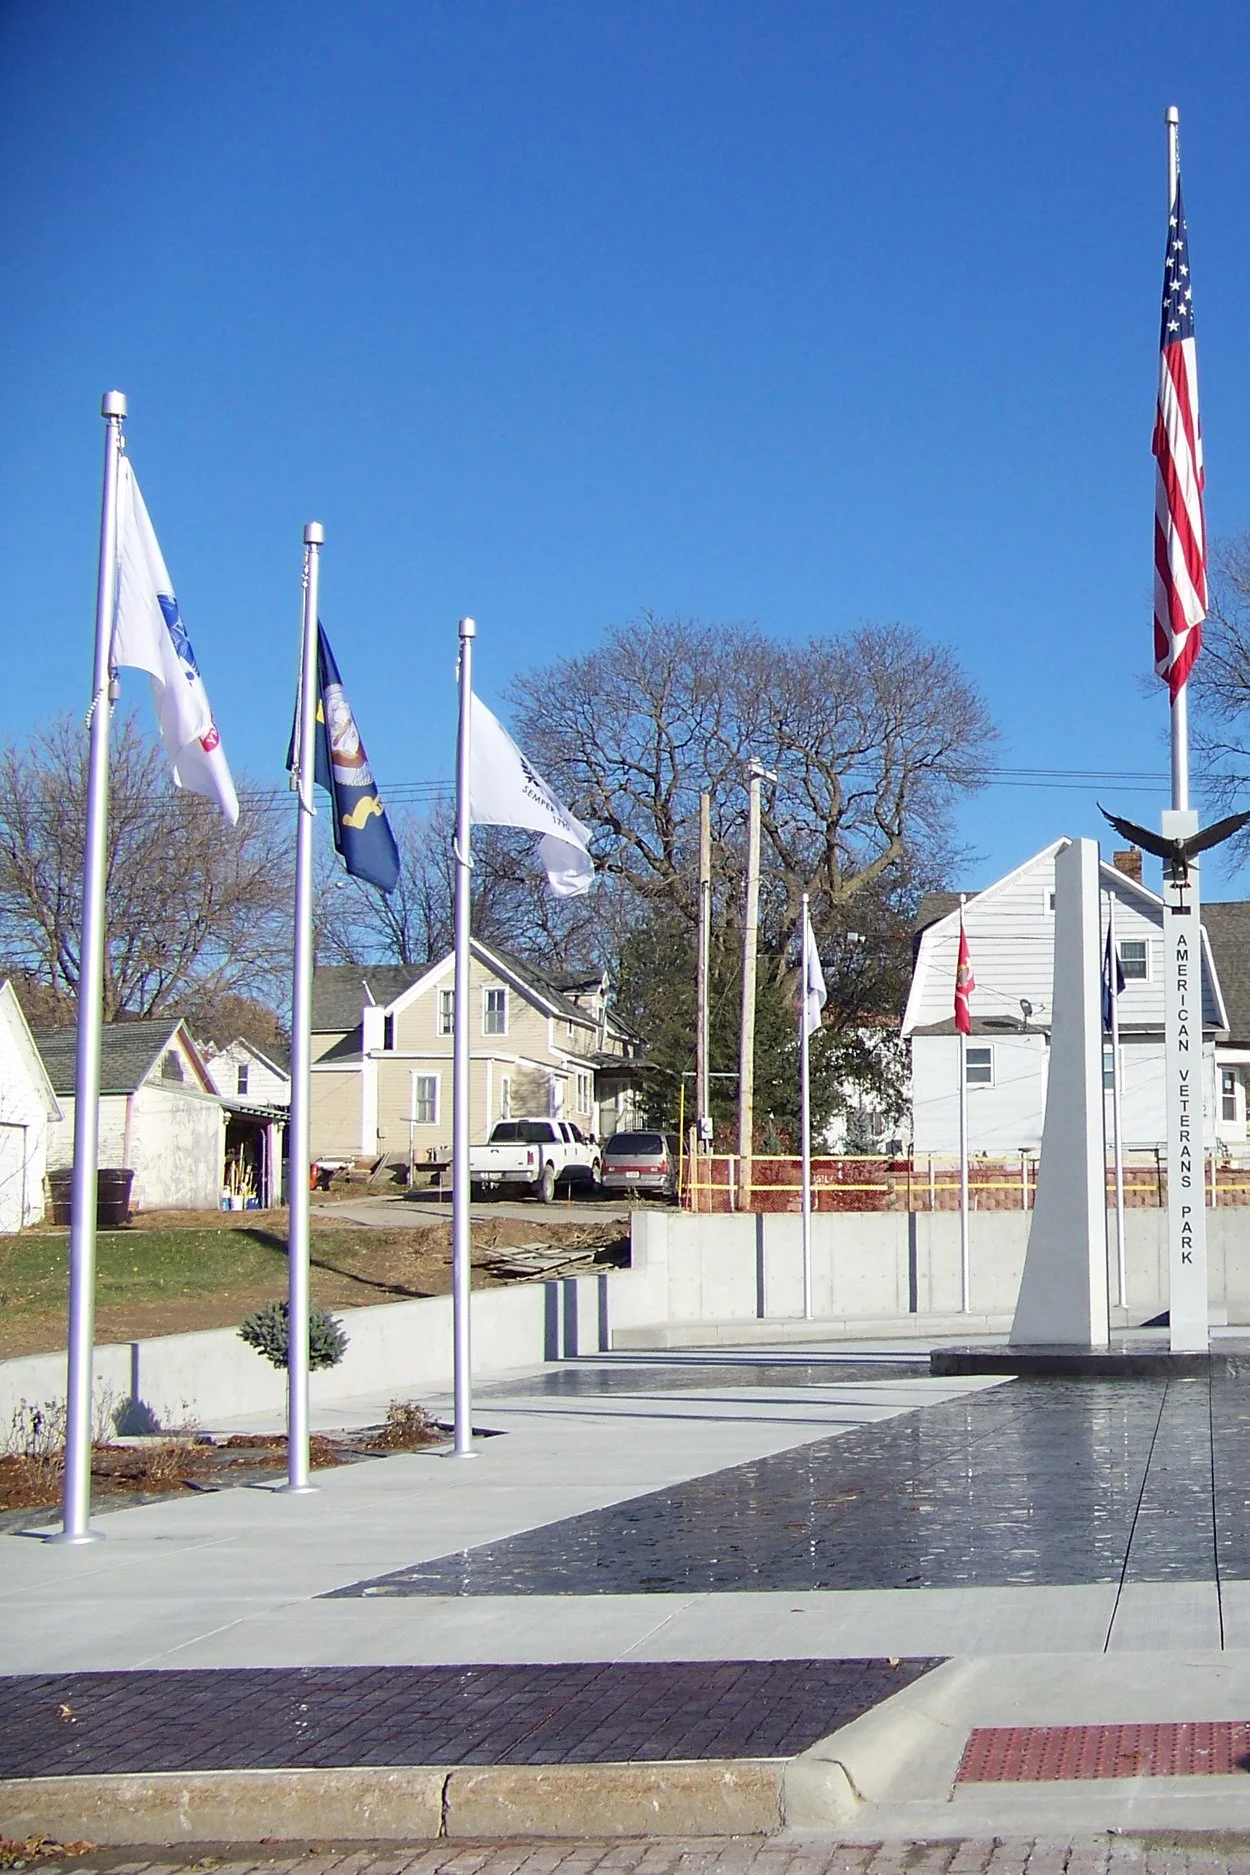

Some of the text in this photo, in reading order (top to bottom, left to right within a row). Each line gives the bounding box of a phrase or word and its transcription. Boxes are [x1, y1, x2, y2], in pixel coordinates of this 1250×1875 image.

[1176, 934, 1193, 1264] AMERICAN VETERANS PARK
